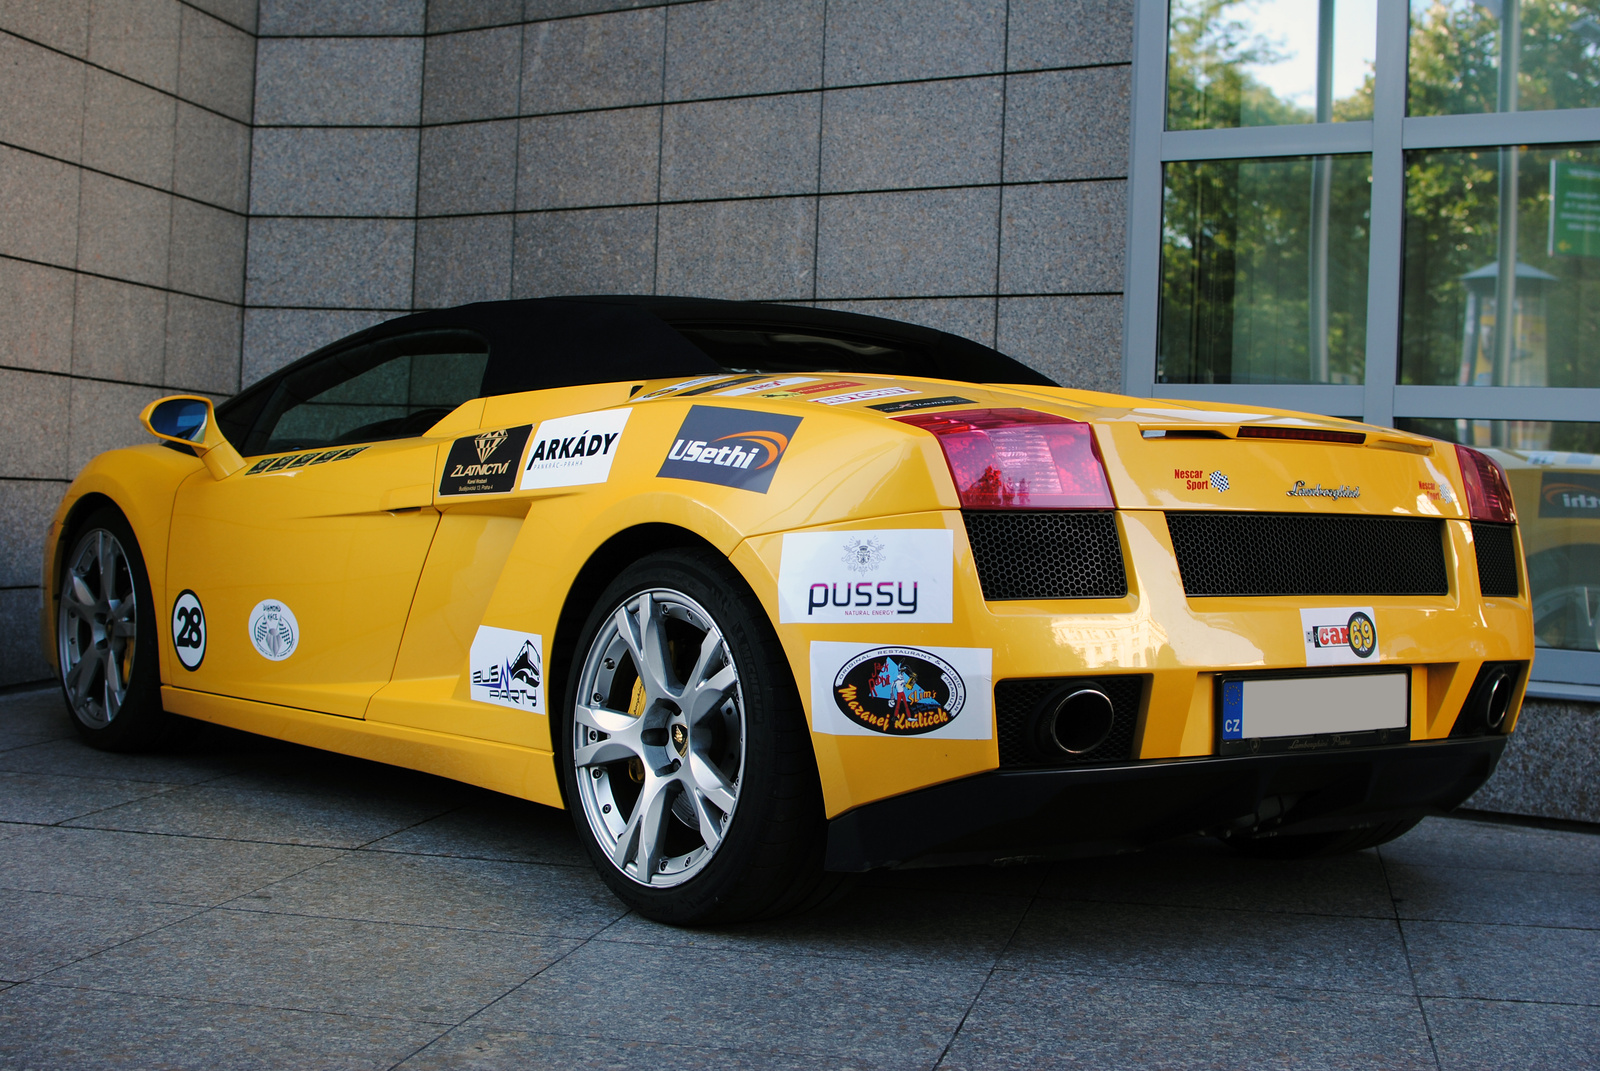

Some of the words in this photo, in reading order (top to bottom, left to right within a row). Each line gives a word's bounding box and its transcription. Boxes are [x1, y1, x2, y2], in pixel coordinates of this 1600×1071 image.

[526, 430, 618, 471] ARKÁDY
[668, 439, 760, 469] USethi
[450, 460, 511, 478] ZLATNICTVÍ
[1174, 469, 1203, 479] Nescar
[1186, 480, 1208, 491] Sport
[1286, 480, 1361, 501] Lamborghini
[808, 581, 918, 616] pussy
[177, 606, 203, 649] 28
[1319, 627, 1349, 645] car
[1350, 620, 1374, 649] 69
[838, 654, 872, 680] ORIGINAL
[877, 649, 931, 660] RESTAURANT
[944, 666, 962, 689] MUSIC
[954, 695, 963, 712] BAR
[872, 662, 890, 678] Jack
[489, 689, 537, 707] PARTY
[868, 674, 892, 699] Rabbit
[943, 676, 956, 709] PRAGUE
[838, 684, 890, 731] Mazanej
[1225, 719, 1240, 733] CZ
